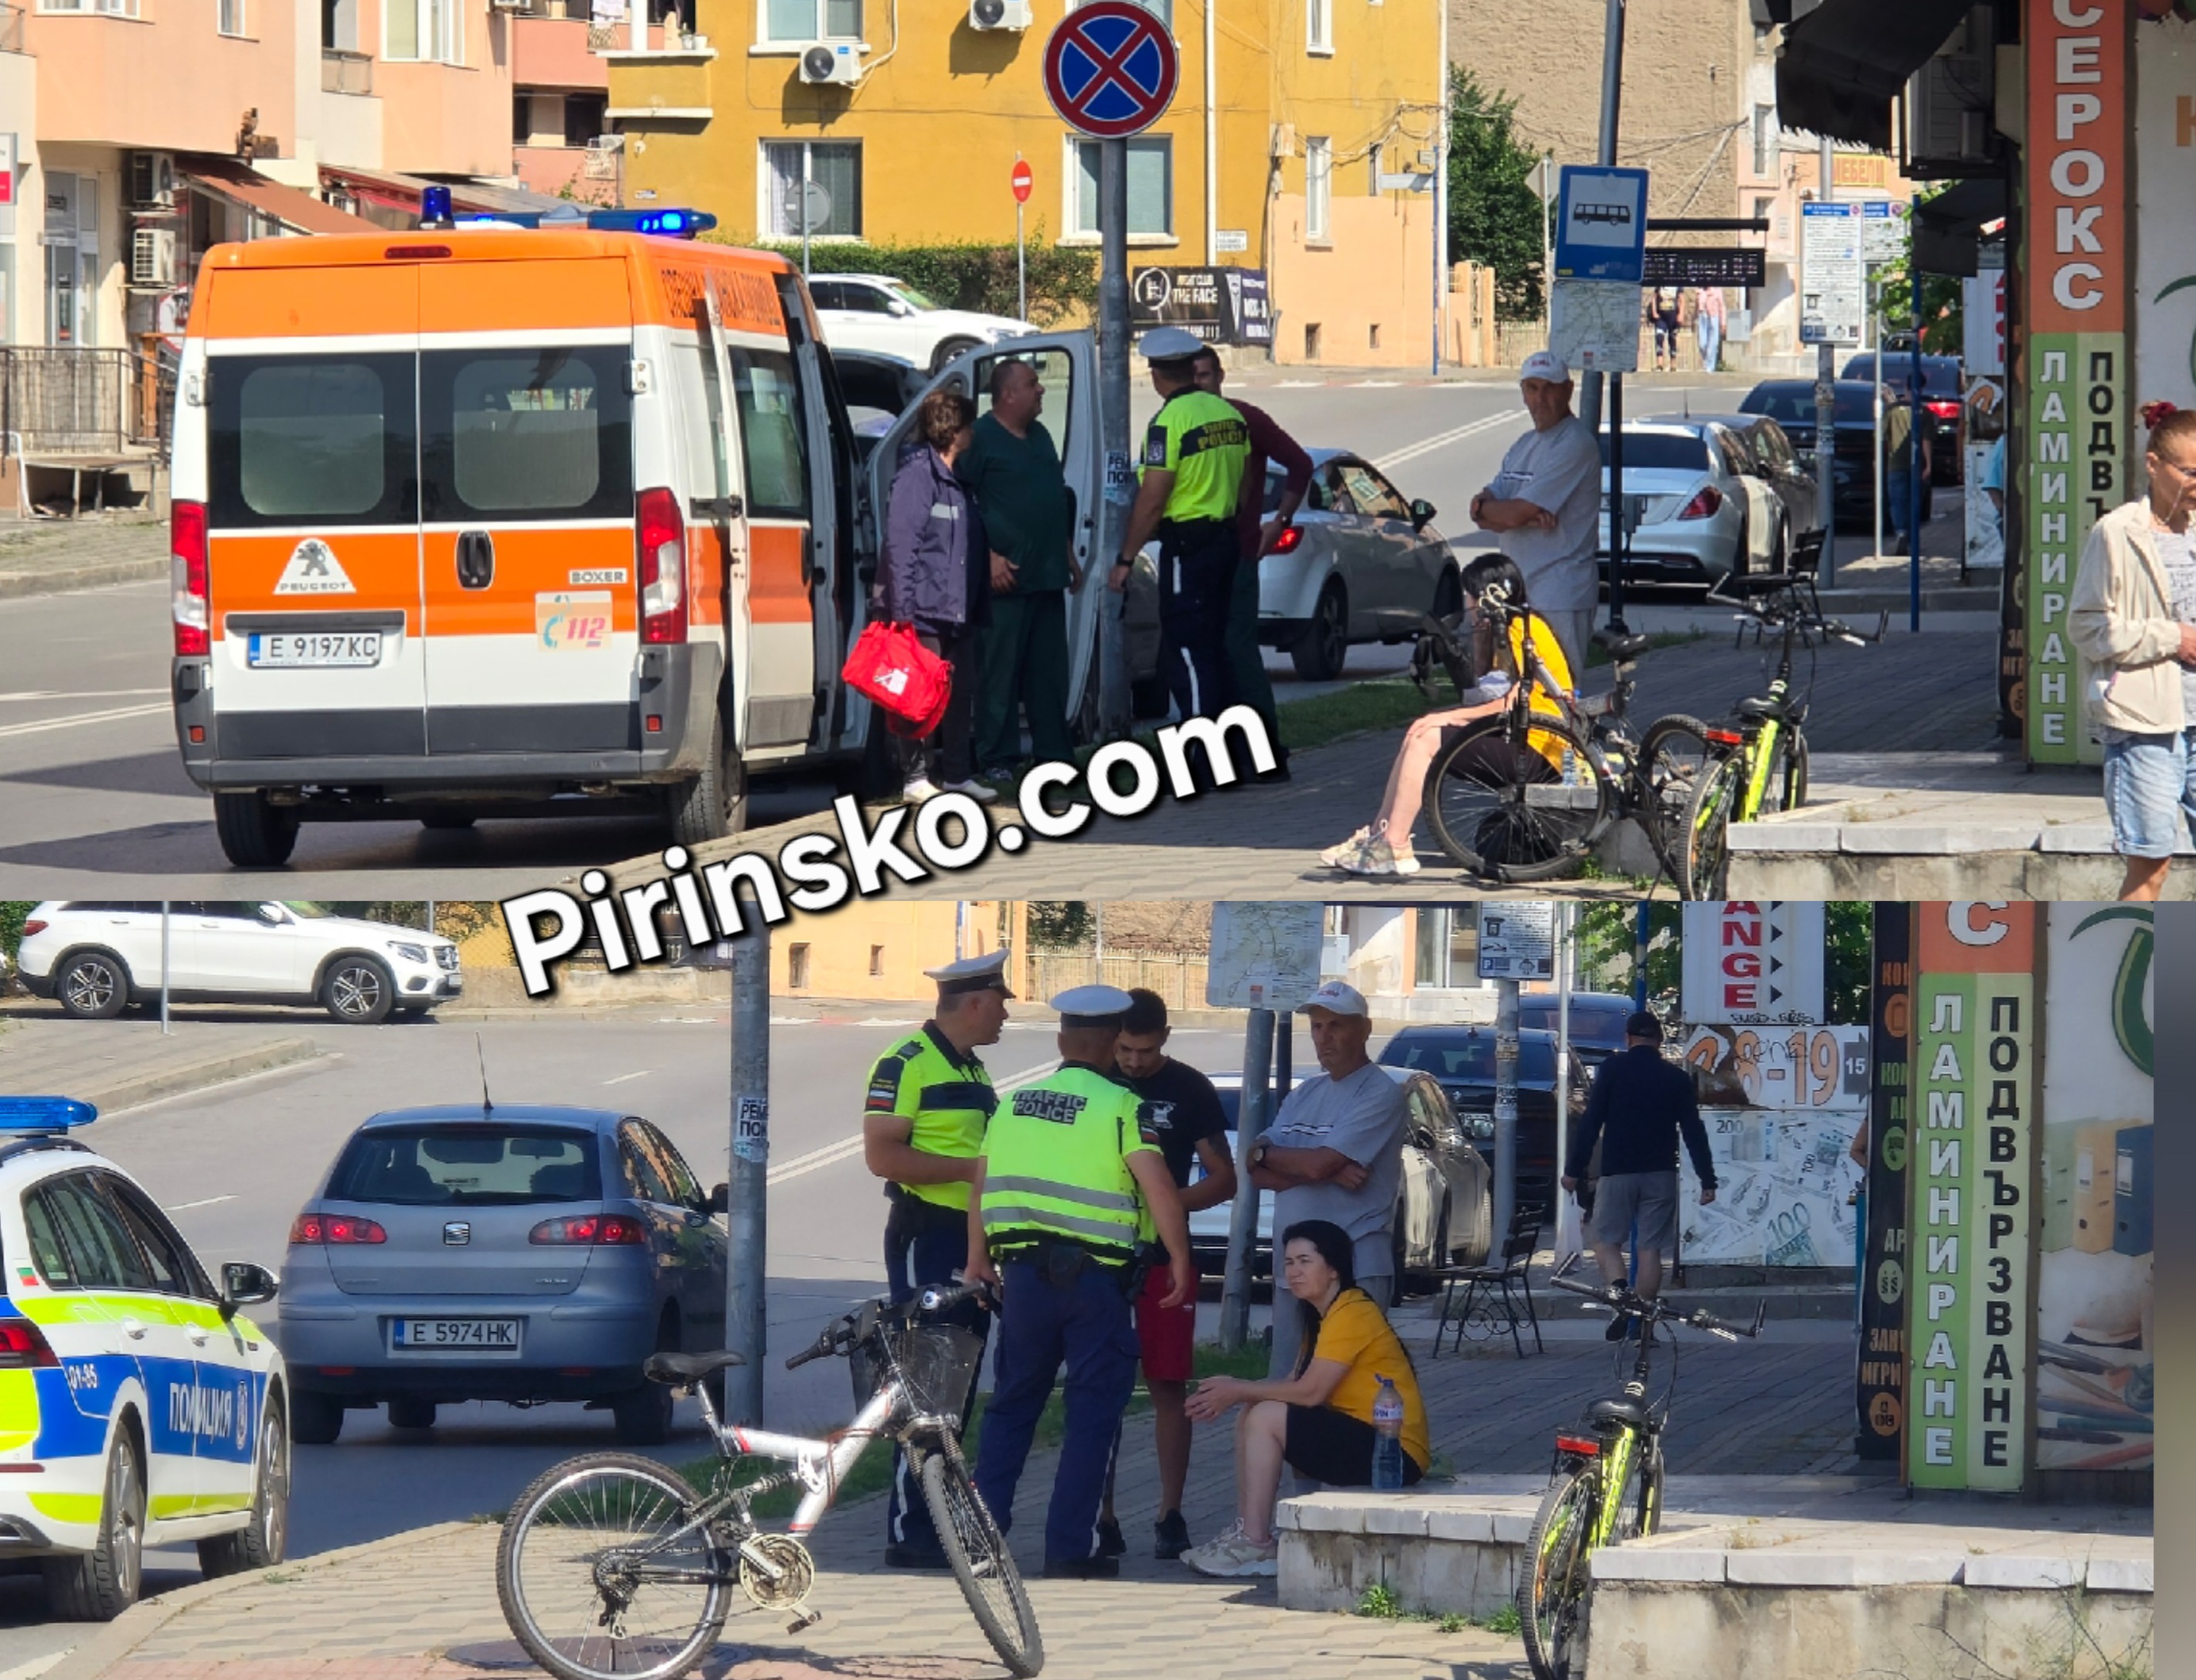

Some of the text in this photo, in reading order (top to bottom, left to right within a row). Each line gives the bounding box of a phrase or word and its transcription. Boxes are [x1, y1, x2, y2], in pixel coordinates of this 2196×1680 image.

[1173, 287, 1191, 304] THE
[1192, 287, 1219, 304] FACE
[2039, 351, 2070, 745] ЛАМИНИРАНЕ
[280, 582, 348, 591] PEUGEOT
[572, 571, 623, 583] BOXER
[566, 618, 606, 640] 112
[1845, 1057, 1866, 1075] 15
[1015, 1089, 1086, 1110] TRAFFIC
[1015, 1100, 1076, 1123] POLICE
[1716, 1119, 1744, 1134] 200
[1767, 1201, 1811, 1241] 100
[1923, 994, 1964, 1466] ЛАМИНИРАНЕ
[1983, 996, 2020, 1467] ПОДВЪРЗВАНЕ
[169, 1382, 233, 1444] ПОЛИЦИЯ
